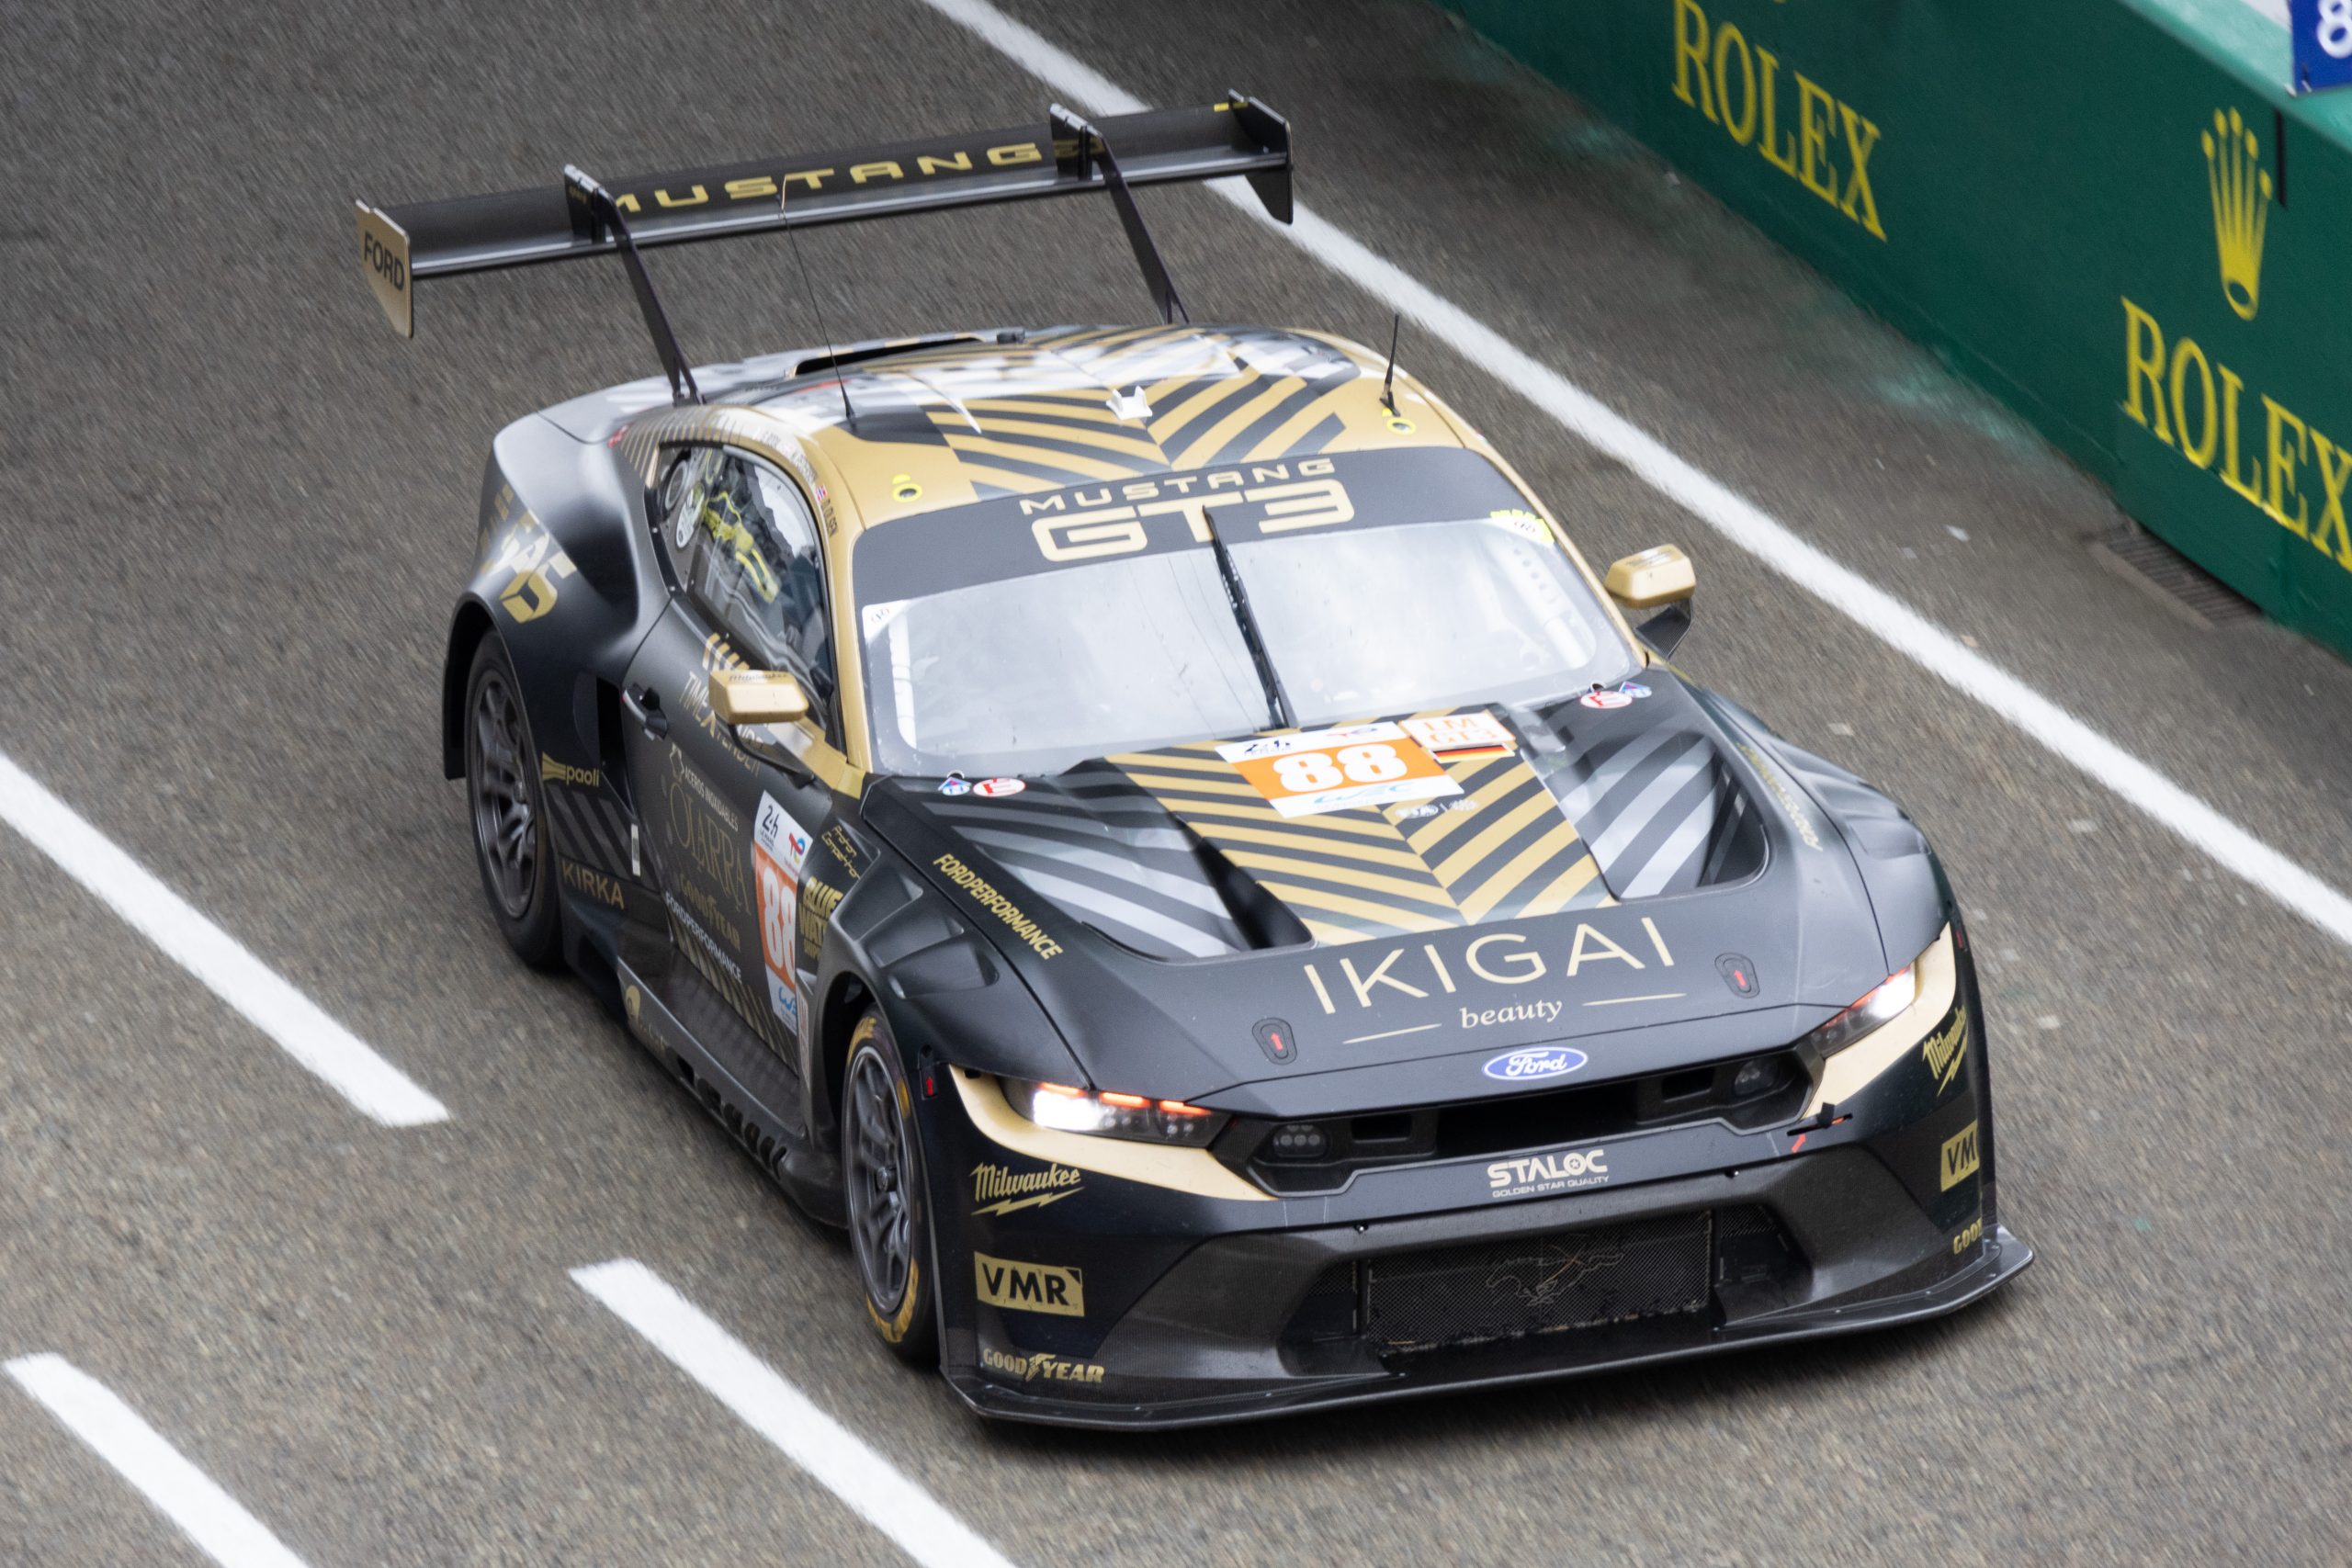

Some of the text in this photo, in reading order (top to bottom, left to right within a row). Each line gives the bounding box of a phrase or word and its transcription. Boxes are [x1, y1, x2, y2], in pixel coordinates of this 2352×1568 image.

[1671, 0, 1887, 243] ROLEX
[364, 231, 404, 291] FORD
[2120, 294, 2352, 574] ROLEX
[1020, 457, 1335, 515] MUSTANG
[1031, 479, 1354, 562] GT3
[566, 765, 600, 786] paoli
[1272, 743, 1408, 793] 88
[561, 858, 625, 910] KIRKA
[763, 866, 797, 987] 88
[1303, 917, 1676, 1014] IKIGAI
[1459, 998, 1564, 1029] beauty
[1505, 1051, 1568, 1077] Ford
[969, 1161, 1081, 1202] Milwaukee
[1487, 1149, 1608, 1188] STALOC
[1492, 1176, 1610, 1198] GOLDEN STAR QUALITY
[982, 1262, 1069, 1306] VMR
